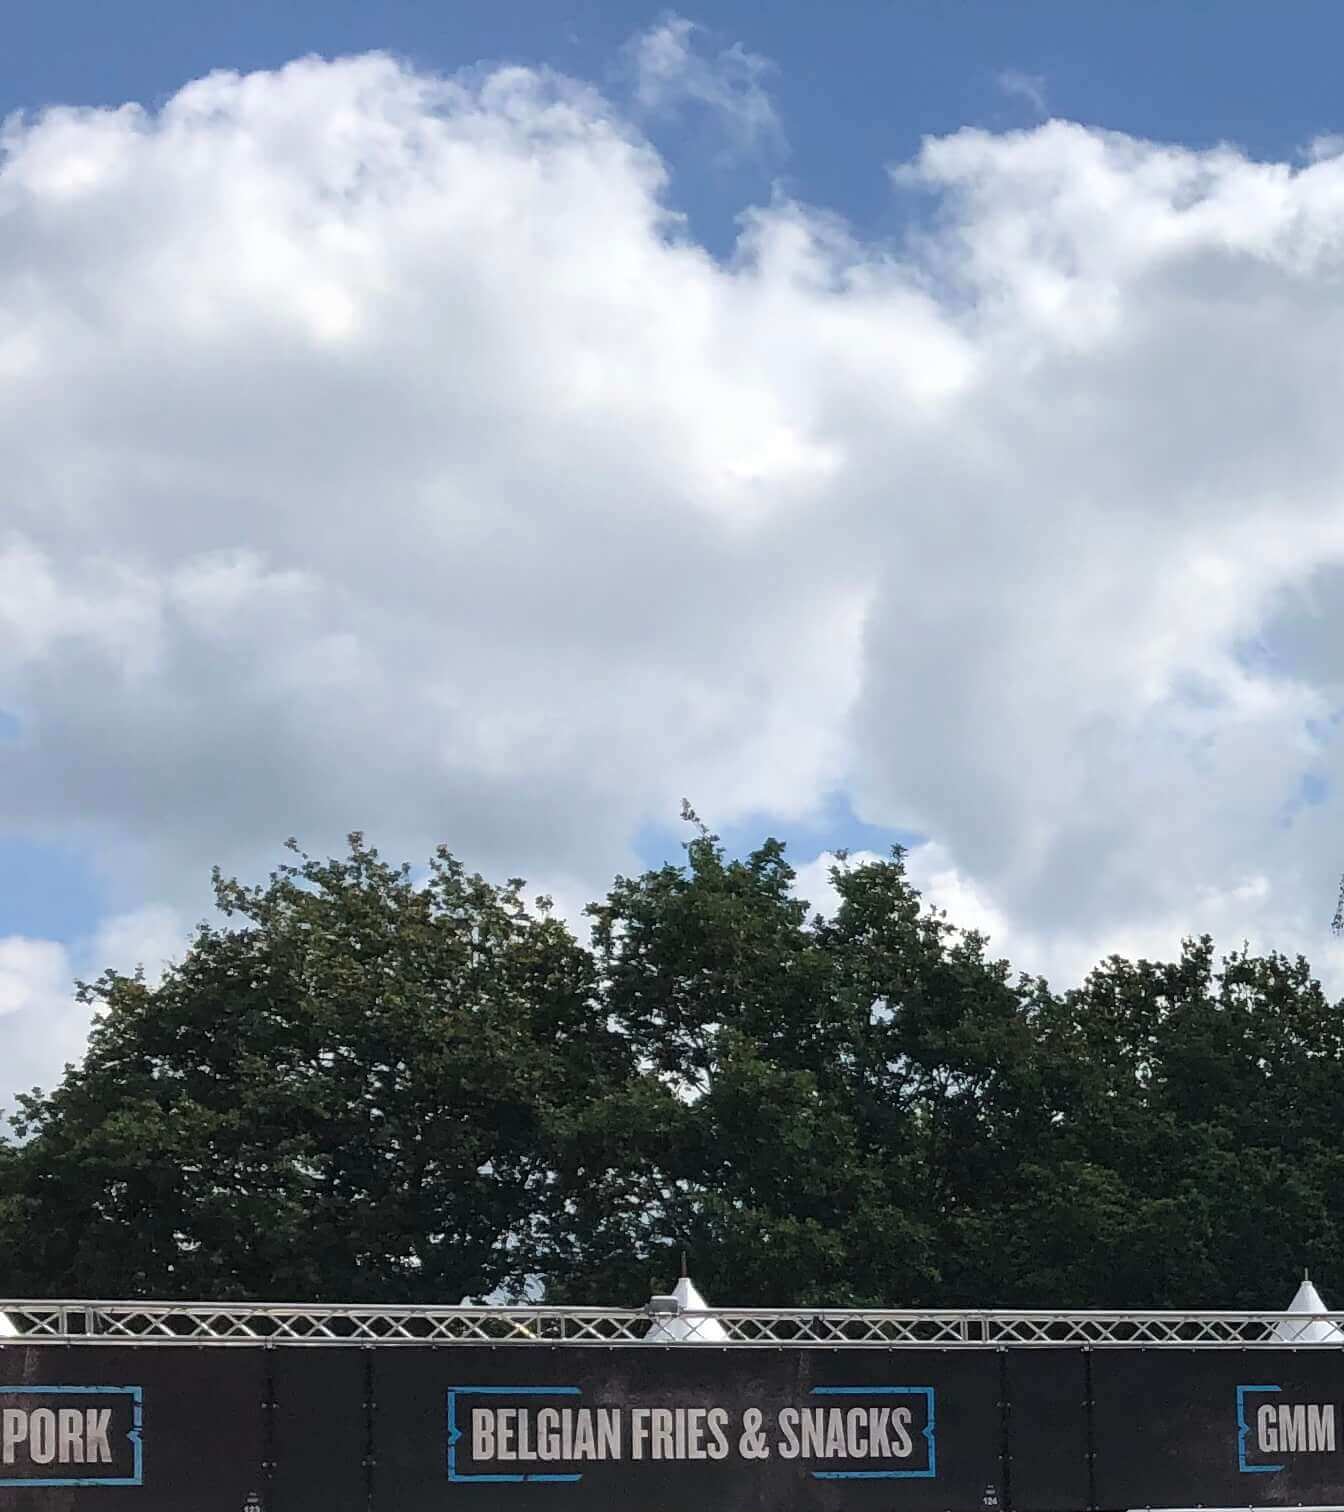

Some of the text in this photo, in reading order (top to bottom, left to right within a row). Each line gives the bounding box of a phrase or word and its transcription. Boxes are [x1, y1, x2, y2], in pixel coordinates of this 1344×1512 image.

[2, 1408, 112, 1464] PORK
[472, 1407, 912, 1461] BELGIAN FRIES & SNACKS
[1257, 1404, 1336, 1452] GMM
